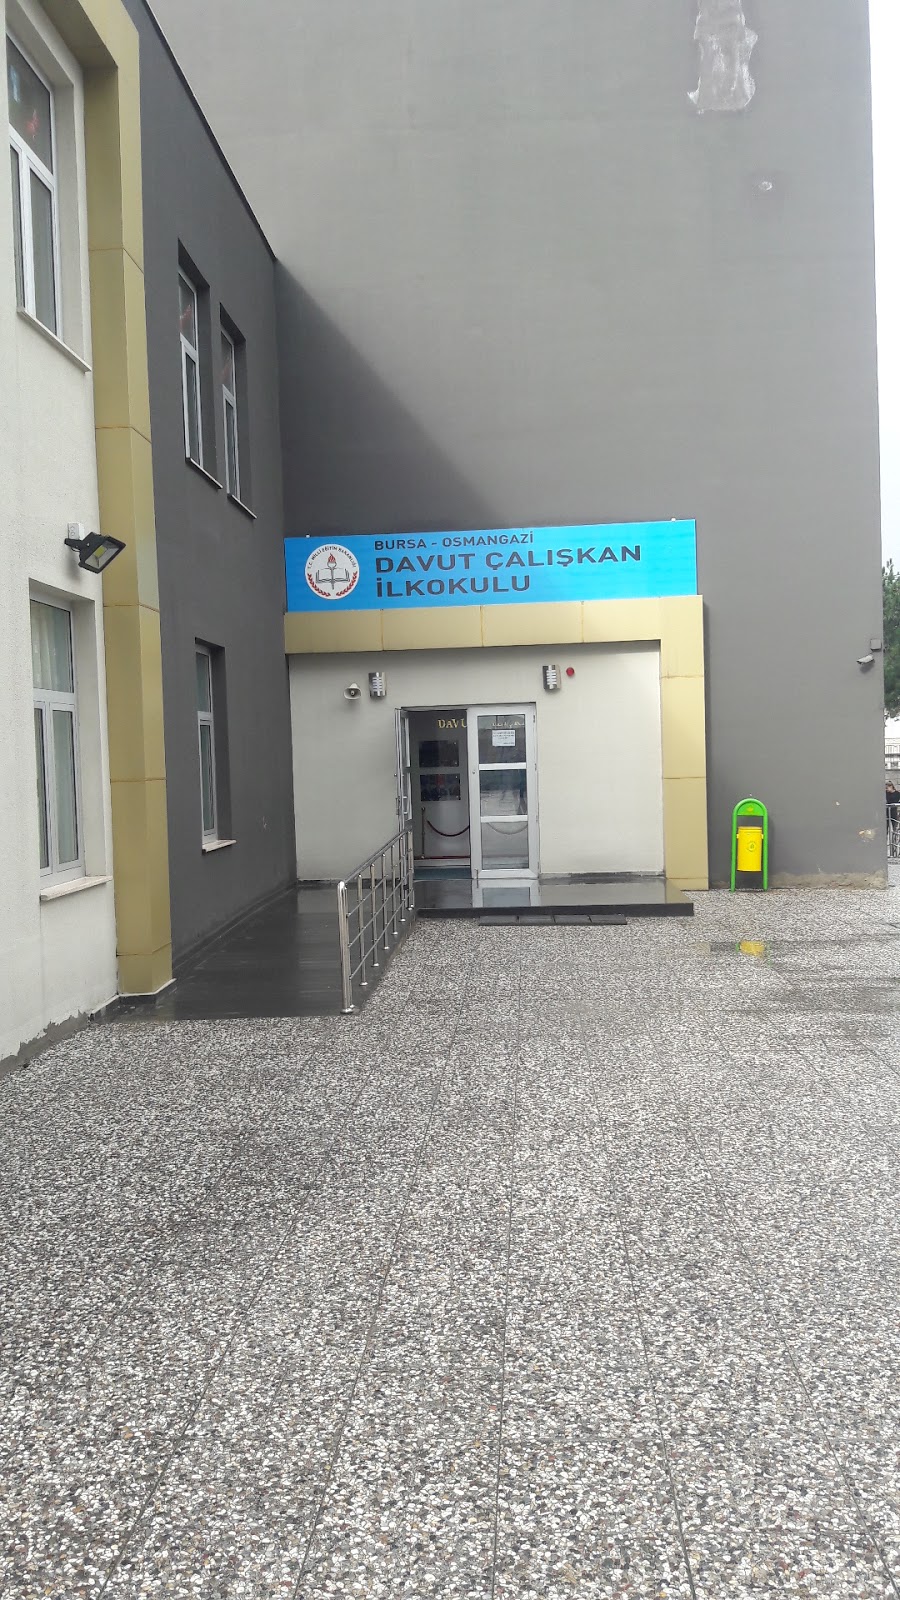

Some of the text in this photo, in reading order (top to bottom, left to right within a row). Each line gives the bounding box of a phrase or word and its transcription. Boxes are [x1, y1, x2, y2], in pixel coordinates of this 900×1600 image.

[374, 538, 427, 551] BURSA
[442, 531, 533, 547] OSMANGAZİ
[375, 545, 641, 573] DAVUT ÇALIŞKAN
[376, 575, 530, 598] İLKOKULU
[437, 718, 467, 728] DAVU
